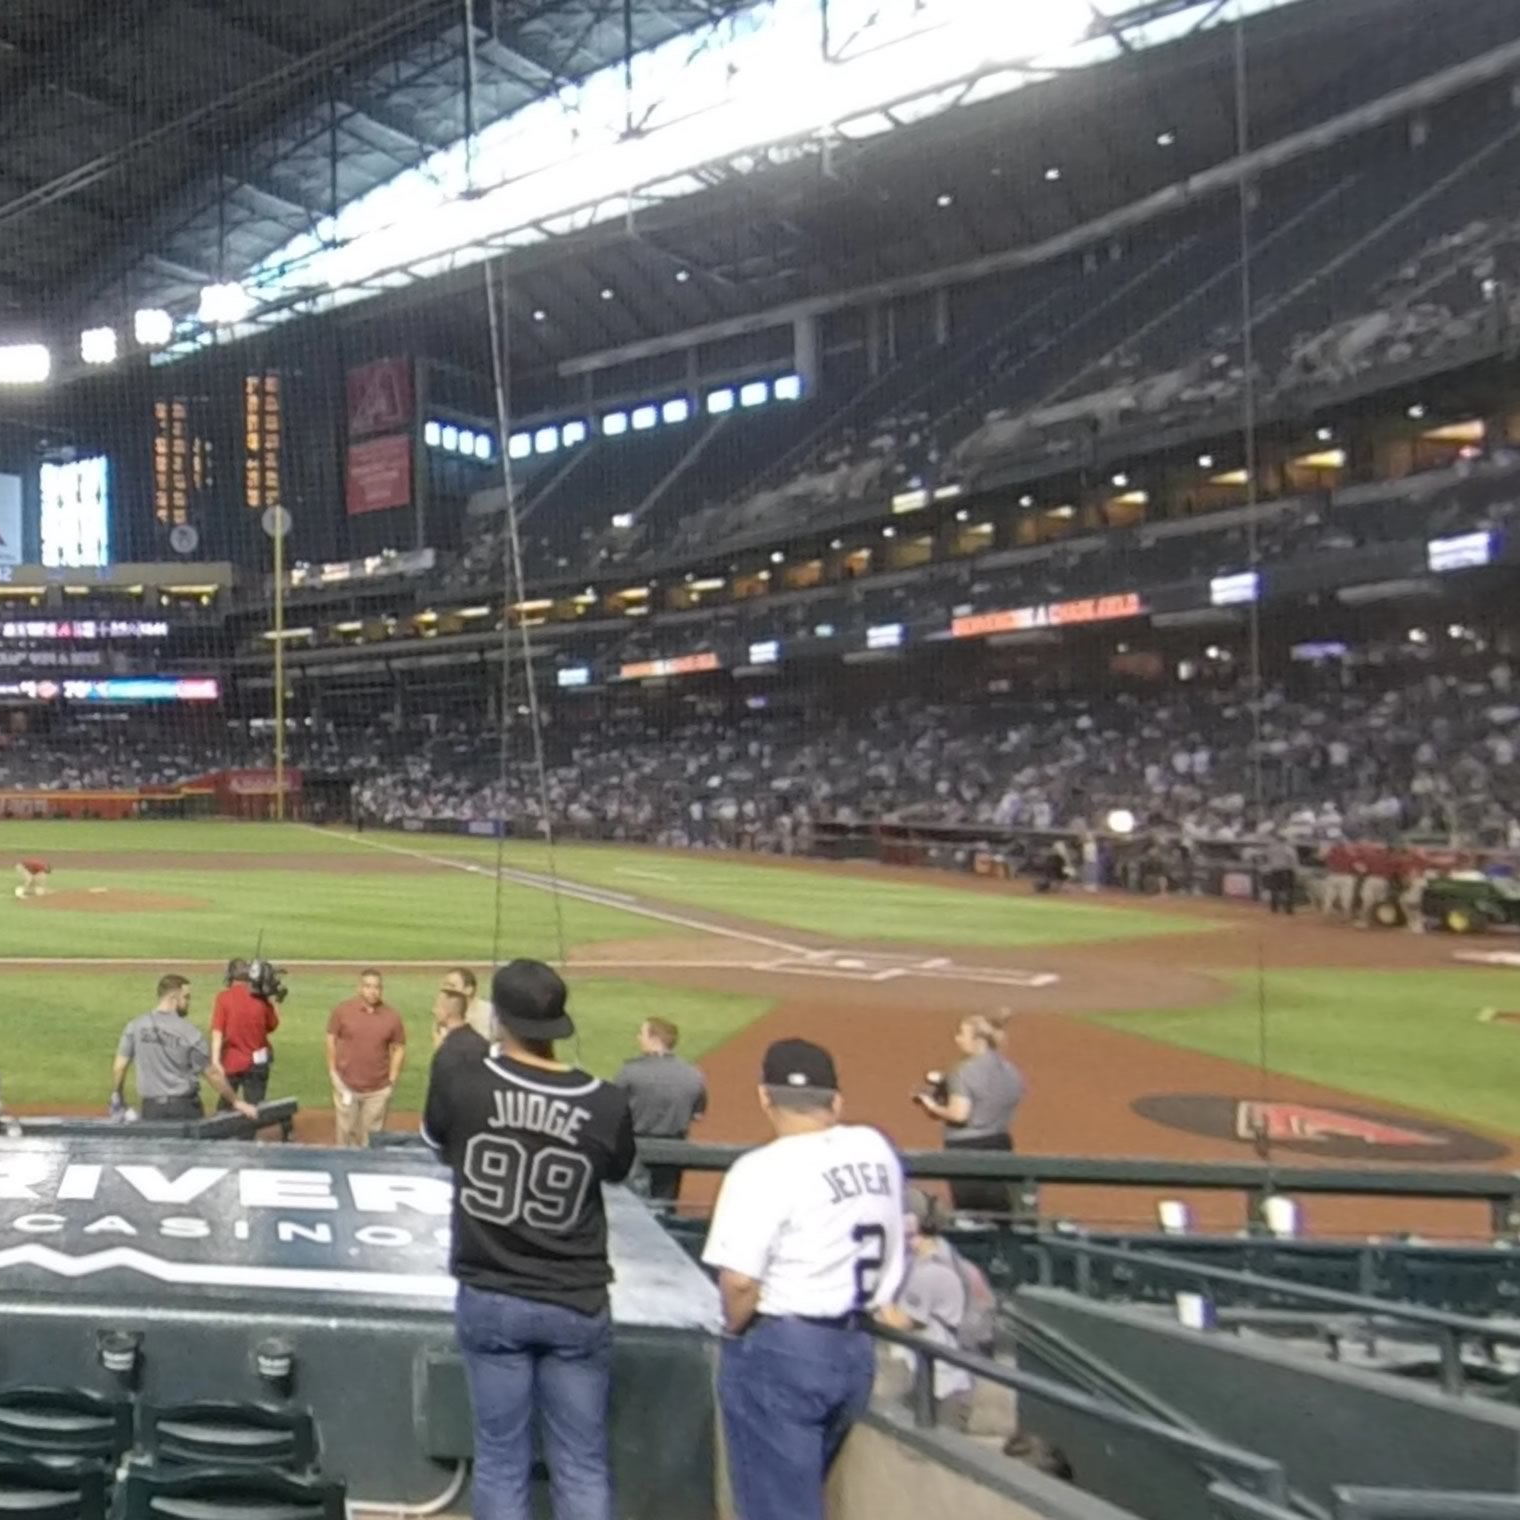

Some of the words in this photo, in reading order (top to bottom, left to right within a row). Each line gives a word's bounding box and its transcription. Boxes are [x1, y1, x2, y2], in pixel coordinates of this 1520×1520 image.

[487, 1090, 592, 1145] JUDGE
[460, 1132, 593, 1231] 99
[822, 1162, 891, 1204] JETER
[851, 1223, 887, 1304] 2
